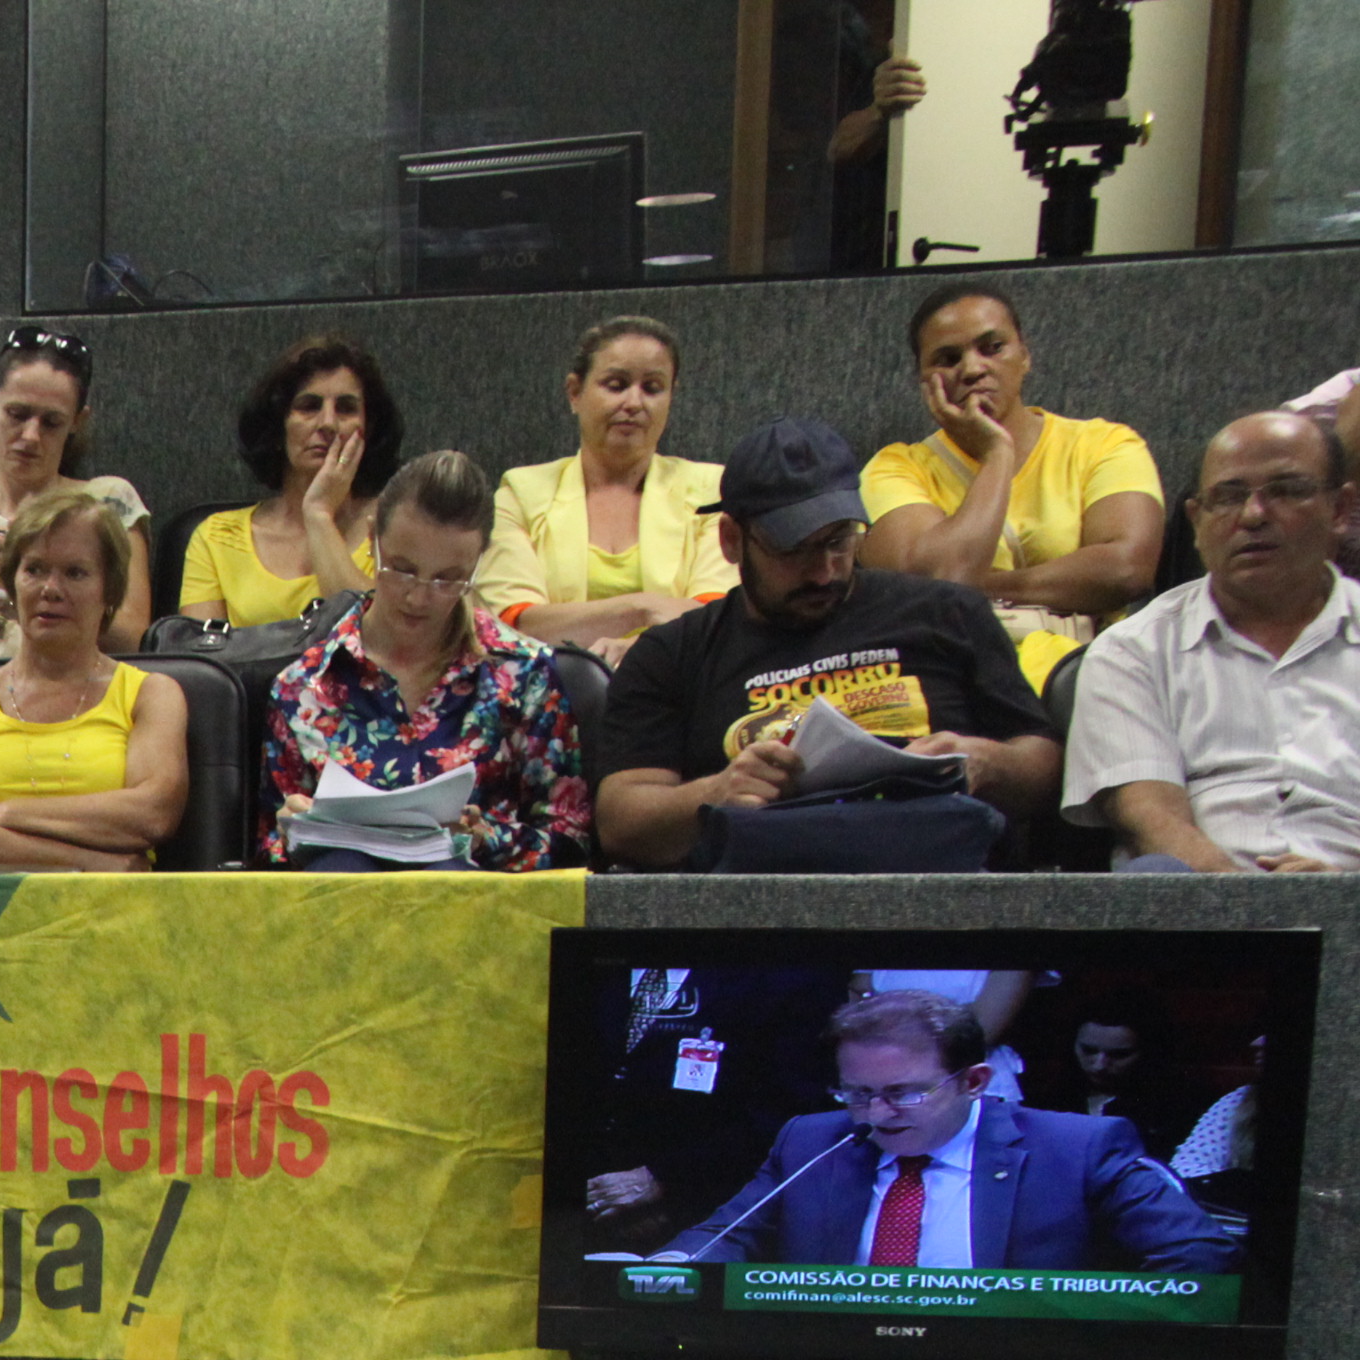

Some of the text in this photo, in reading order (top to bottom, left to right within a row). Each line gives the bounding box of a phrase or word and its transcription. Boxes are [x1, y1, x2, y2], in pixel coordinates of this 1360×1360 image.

[745, 648, 899, 690] POLICIAIS CIVIS PEDEM
[748, 662, 902, 711] SOCORRO
[745, 1269, 1200, 1297] COMISSÃO DE FINANÇAS E TRIBUTAÇÃO
[744, 1290, 977, 1306] comifinan@alesc.sc.gov.br
[875, 1326, 927, 1337] SONY
